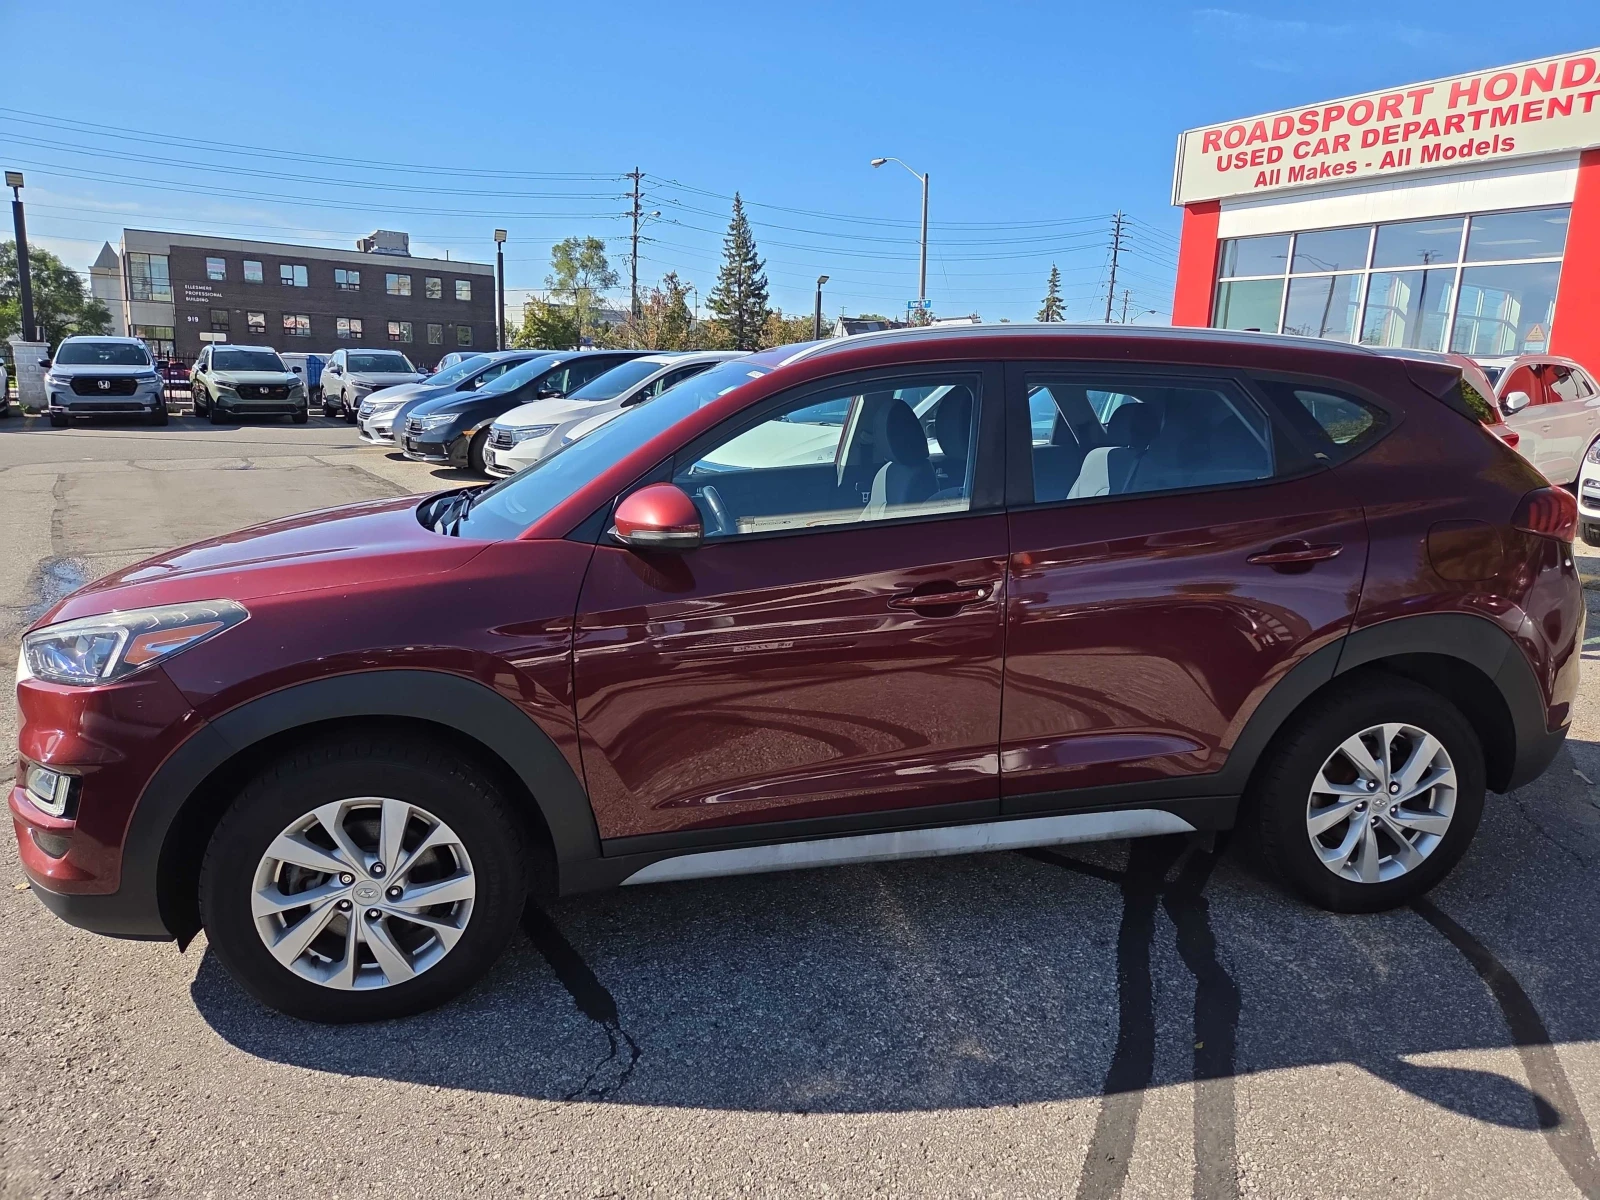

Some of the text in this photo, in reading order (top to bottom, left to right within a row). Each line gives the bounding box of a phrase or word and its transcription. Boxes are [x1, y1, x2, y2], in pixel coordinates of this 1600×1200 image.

[1202, 57, 1600, 154] ROADSPORT HOND
[1216, 90, 1600, 172] USED CAR DEPARTMENT
[1254, 169, 1281, 188] All
[1288, 160, 1358, 183] Makes
[1379, 148, 1412, 170] All
[1420, 134, 1516, 164] Models
